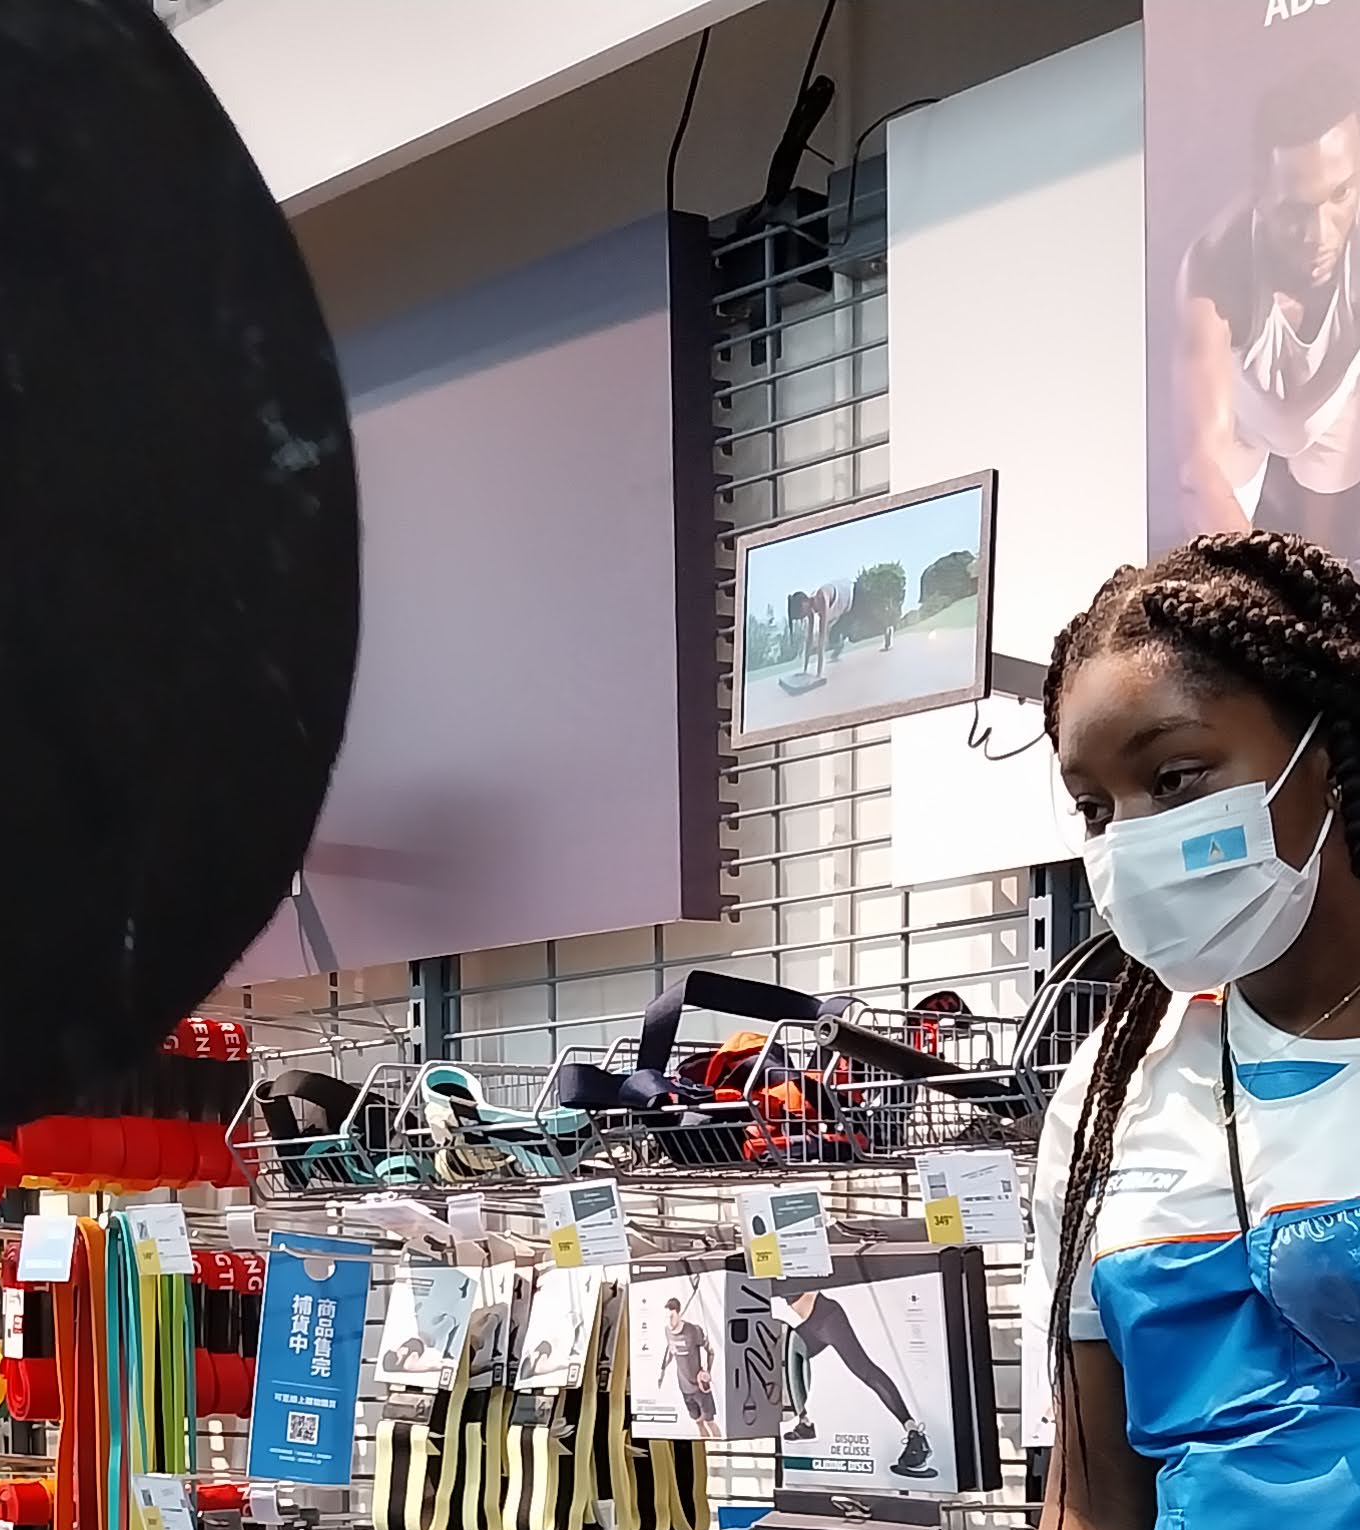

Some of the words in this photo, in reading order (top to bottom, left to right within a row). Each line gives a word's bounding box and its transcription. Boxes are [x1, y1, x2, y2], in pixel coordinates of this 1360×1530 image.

[289, 1294, 313, 1354] 補貨中
[310, 1298, 338, 1378] 商品售完
